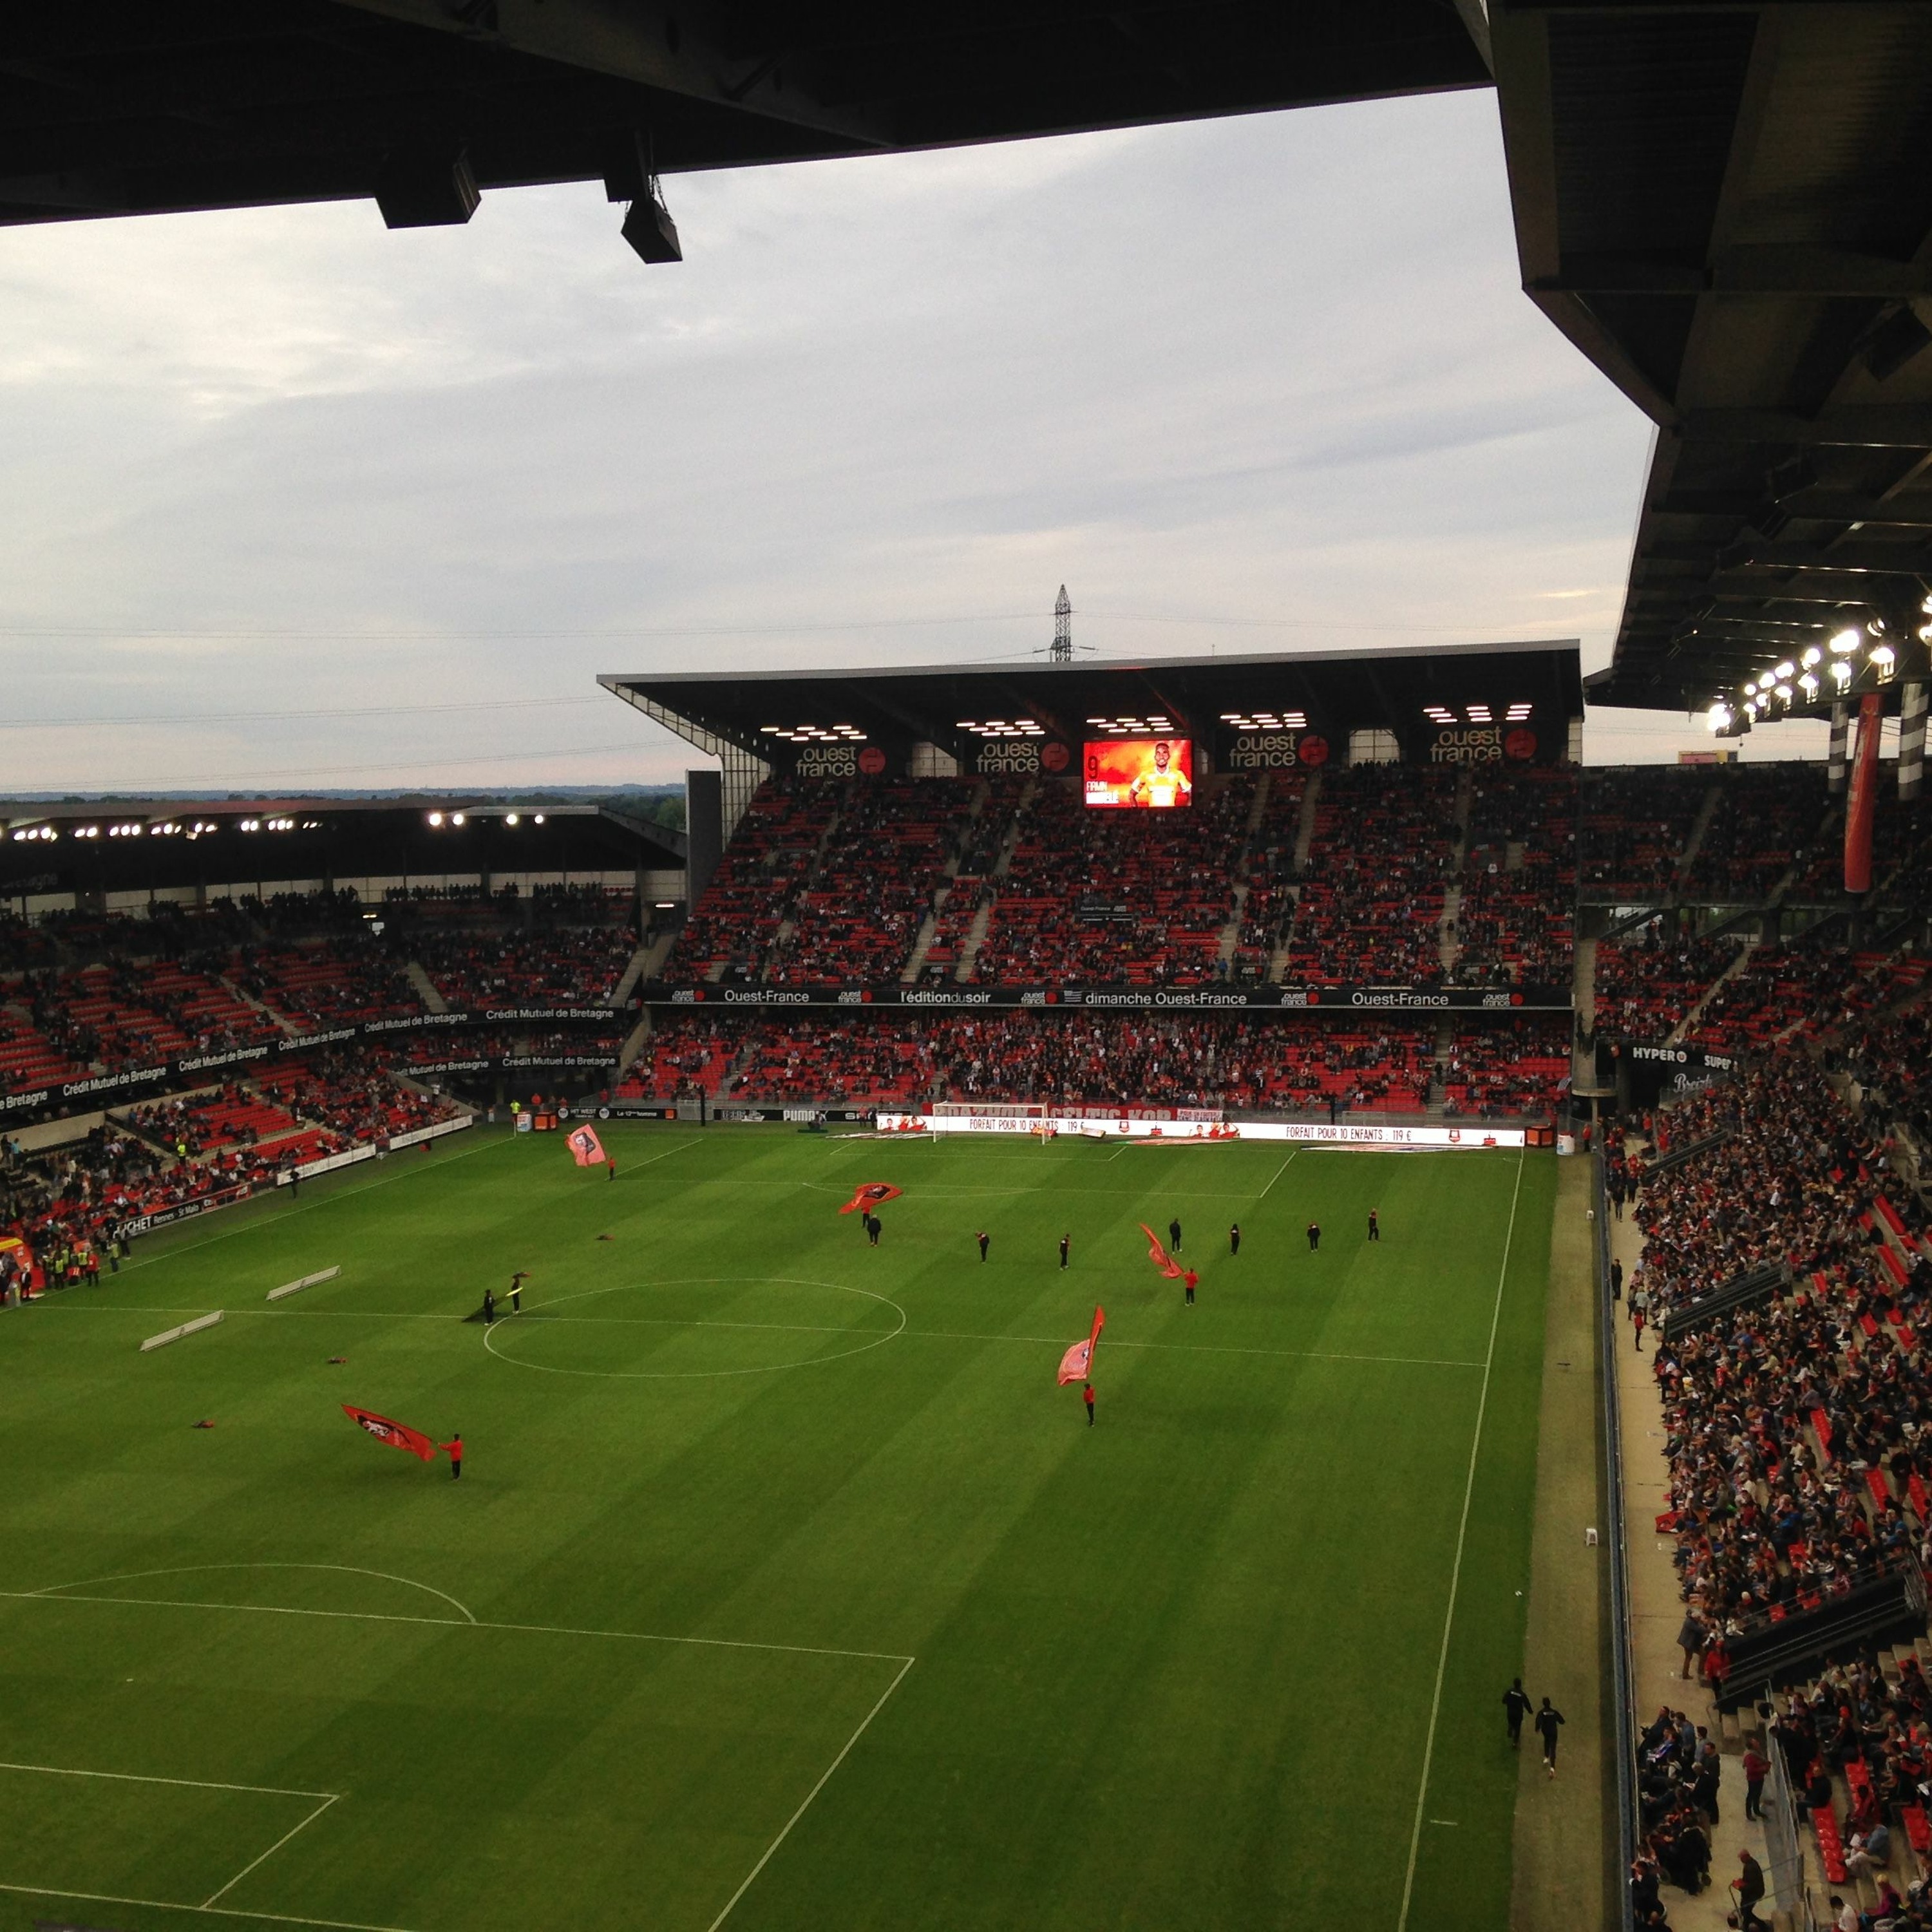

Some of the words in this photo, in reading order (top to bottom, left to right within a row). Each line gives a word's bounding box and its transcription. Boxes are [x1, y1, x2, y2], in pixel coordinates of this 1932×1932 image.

[1236, 732, 1296, 752] ouest
[1439, 725, 1502, 746] ouest
[802, 746, 857, 762] ouest
[1229, 748, 1296, 767] france
[1430, 743, 1502, 762] france
[795, 760, 856, 777] france
[976, 754, 1040, 773] france
[1088, 755, 1098, 779] 9
[724, 990, 810, 1003] Ouest-France
[1085, 992, 1152, 1005] dimanche
[1155, 992, 1247, 1005] Ouest-France
[1352, 992, 1448, 1005] Ouest-France
[412, 1016, 422, 1026] de
[424, 1014, 468, 1025] Bretagne
[486, 1009, 518, 1019] Crédit
[520, 1009, 554, 1018] Mutuel
[556, 1009, 568, 1018] de
[570, 1009, 614, 1019] Bretagne
[202, 1053, 226, 1067] Mutuel
[227, 1051, 236, 1062] de
[237, 1046, 268, 1059] Bretagne
[533, 1057, 563, 1065] Mutuel
[565, 1056, 575, 1065] de
[577, 1057, 616, 1067] Bretagne
[1633, 1046, 1675, 1063] HYPER
[1704, 1054, 1732, 1070] SUPER
[435, 1062, 446, 1072] de
[448, 1060, 489, 1070] Bretagne
[90, 1074, 118, 1090] Mutuel
[119, 1072, 129, 1084] de
[131, 1066, 167, 1083] Bretagne
[6, 1090, 48, 1108] Bretagne
[783, 1110, 817, 1121] PUMA
[970, 1119, 995, 1130] FORFAIT
[999, 1119, 1016, 1130] POUR
[1019, 1120, 1026, 1130] 10
[1068, 1121, 1077, 1132] 119
[1287, 1126, 1314, 1139] FORFAIT
[1318, 1127, 1336, 1139] POUR
[1341, 1128, 1347, 1139] 10
[1350, 1128, 1383, 1141] ENFANTS
[1393, 1130, 1403, 1141] 119
